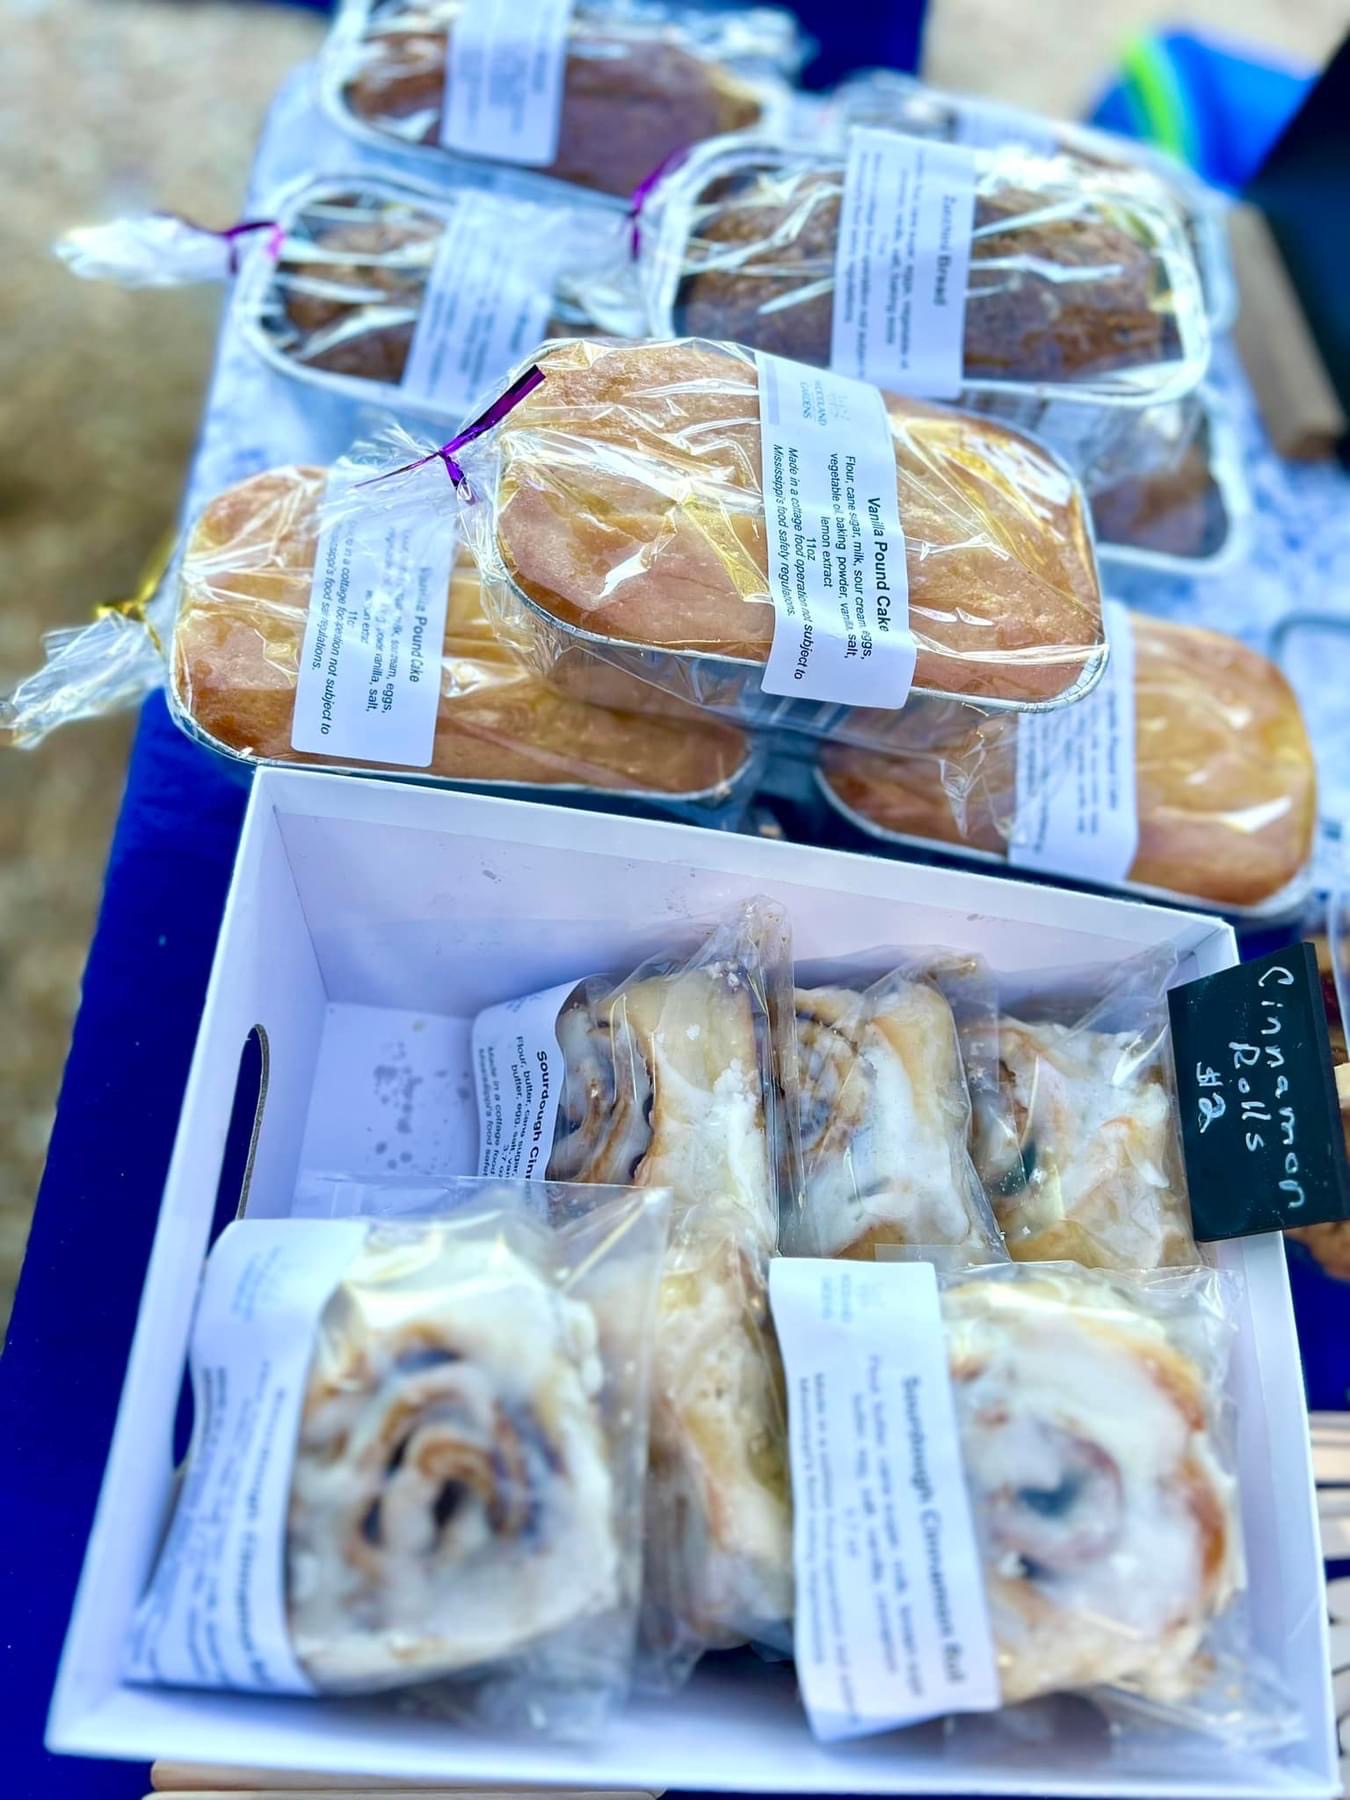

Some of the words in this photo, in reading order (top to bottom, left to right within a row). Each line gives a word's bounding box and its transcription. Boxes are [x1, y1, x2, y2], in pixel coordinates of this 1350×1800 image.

[933, 255, 952, 306] Bread
[772, 444, 783, 504] Mississippi's
[788, 448, 798, 475] Made
[828, 453, 841, 501] vegetable
[845, 455, 856, 483] Flour,
[790, 477, 800, 486] in
[792, 498, 803, 531] cottage
[846, 487, 856, 510] cane
[777, 506, 788, 528] food
[821, 516, 831, 547] lemon
[868, 497, 884, 536] Vanilla
[778, 529, 790, 560] safety
[794, 534, 805, 557] food
[806, 538, 816, 561] 11oz
[836, 517, 846, 550] baking
[822, 550, 833, 587] extract
[853, 542, 864, 566] milk,
[874, 541, 890, 591] Pound
[323, 577, 335, 600] food
[336, 567, 350, 604] cottage
[779, 562, 796, 616] regulations.
[794, 558, 807, 607] operation
[836, 556, 849, 598] powder,
[854, 570, 862, 594] sour
[877, 596, 891, 632] Cake
[411, 616, 428, 658] Pound
[798, 624, 814, 667] subject
[844, 634, 858, 659] salt,
[861, 631, 873, 660] eggs,
[328, 658, 338, 676] not
[409, 659, 424, 682] Cake
[794, 669, 805, 679] to
[321, 678, 336, 721] subject
[366, 689, 379, 713] salt,
[381, 683, 395, 713] eggs,
[320, 723, 331, 735] to
[487, 1047, 497, 1077] Made
[516, 1036, 527, 1068] Flour,
[493, 1080, 499, 1090] in
[511, 1064, 522, 1100] butter,
[523, 1071, 533, 1107] butter,
[533, 1051, 549, 1142] Sourdough
[1196, 1062, 1226, 1134] $2
[1228, 1041, 1271, 1152] Rolls
[1258, 966, 1305, 1209] Cinnamon
[486, 1120, 494, 1145] food
[494, 1104, 502, 1145] cottage
[520, 1110, 530, 1138] cane
[490, 1149, 499, 1175] food
[512, 1140, 524, 1176] sugar,
[919, 1508, 954, 1639] Cinnamon
